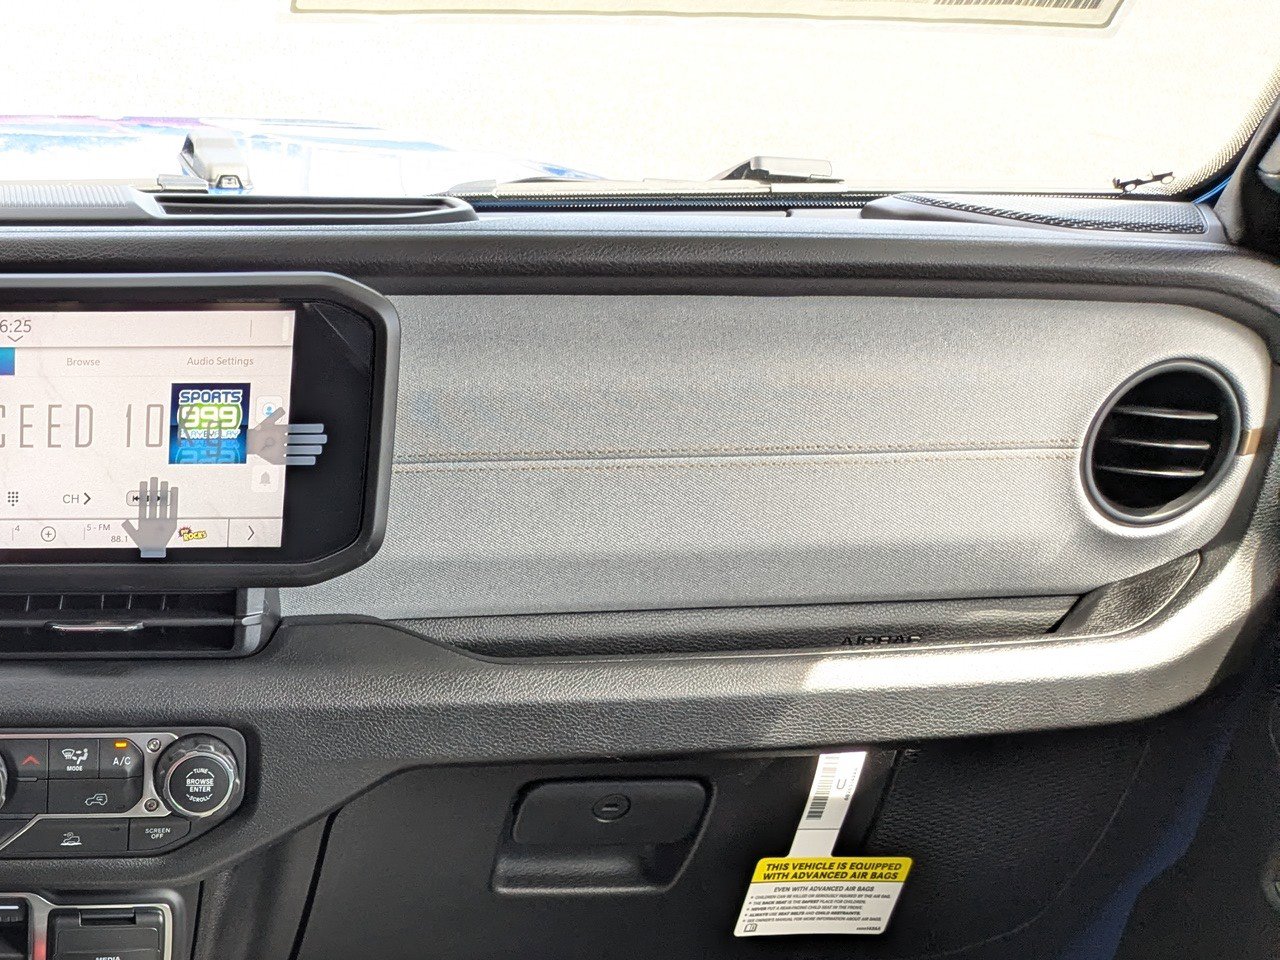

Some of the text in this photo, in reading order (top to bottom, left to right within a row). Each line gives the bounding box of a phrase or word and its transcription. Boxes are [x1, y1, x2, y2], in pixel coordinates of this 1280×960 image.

[0, 319, 32, 333] 6:25
[66, 357, 101, 367] Browse
[186, 355, 254, 369] Audio Settings
[179, 391, 241, 403] SPORTS
[180, 405, 239, 430] 999
[62, 494, 80, 504] CH
[113, 756, 131, 766] A/C
[145, 827, 171, 835] SCREEN
[765, 862, 902, 871] THIS VEHICLE IS EQUIPPED
[762, 871, 899, 880] WITH ADVANCED AIR BAGS
